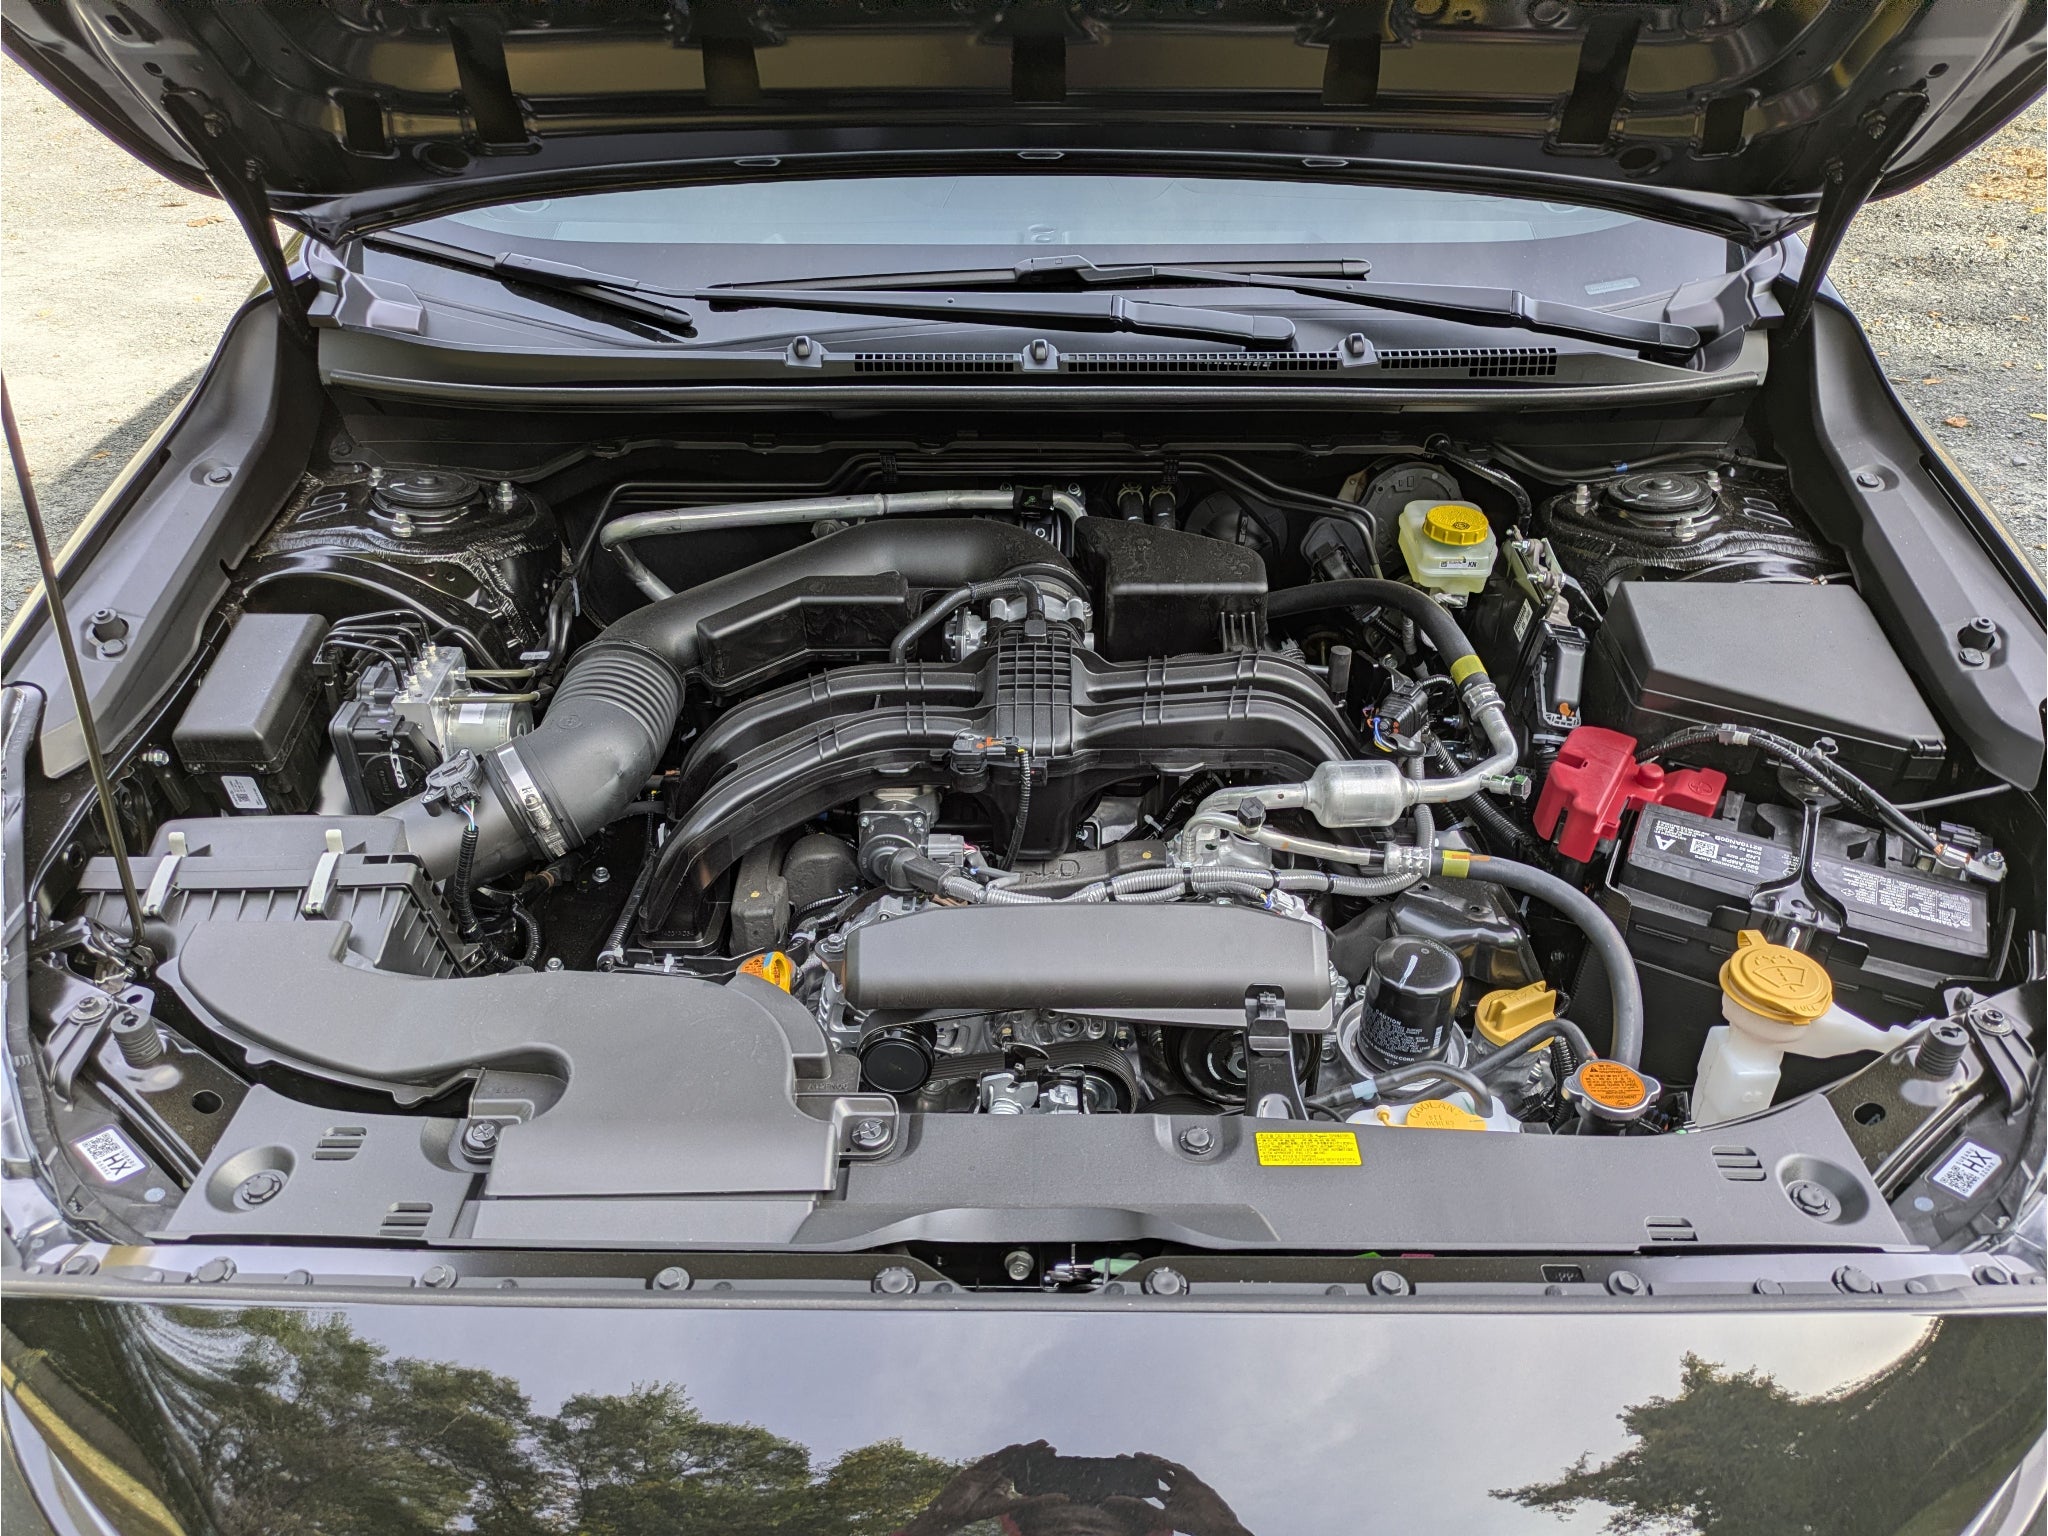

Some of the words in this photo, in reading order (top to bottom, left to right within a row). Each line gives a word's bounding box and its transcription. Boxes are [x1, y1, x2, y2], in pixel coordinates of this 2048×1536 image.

[1375, 1009, 1402, 1026] CAUTION
[103, 1152, 131, 1176] HX
[1962, 1150, 1993, 1174] HX
